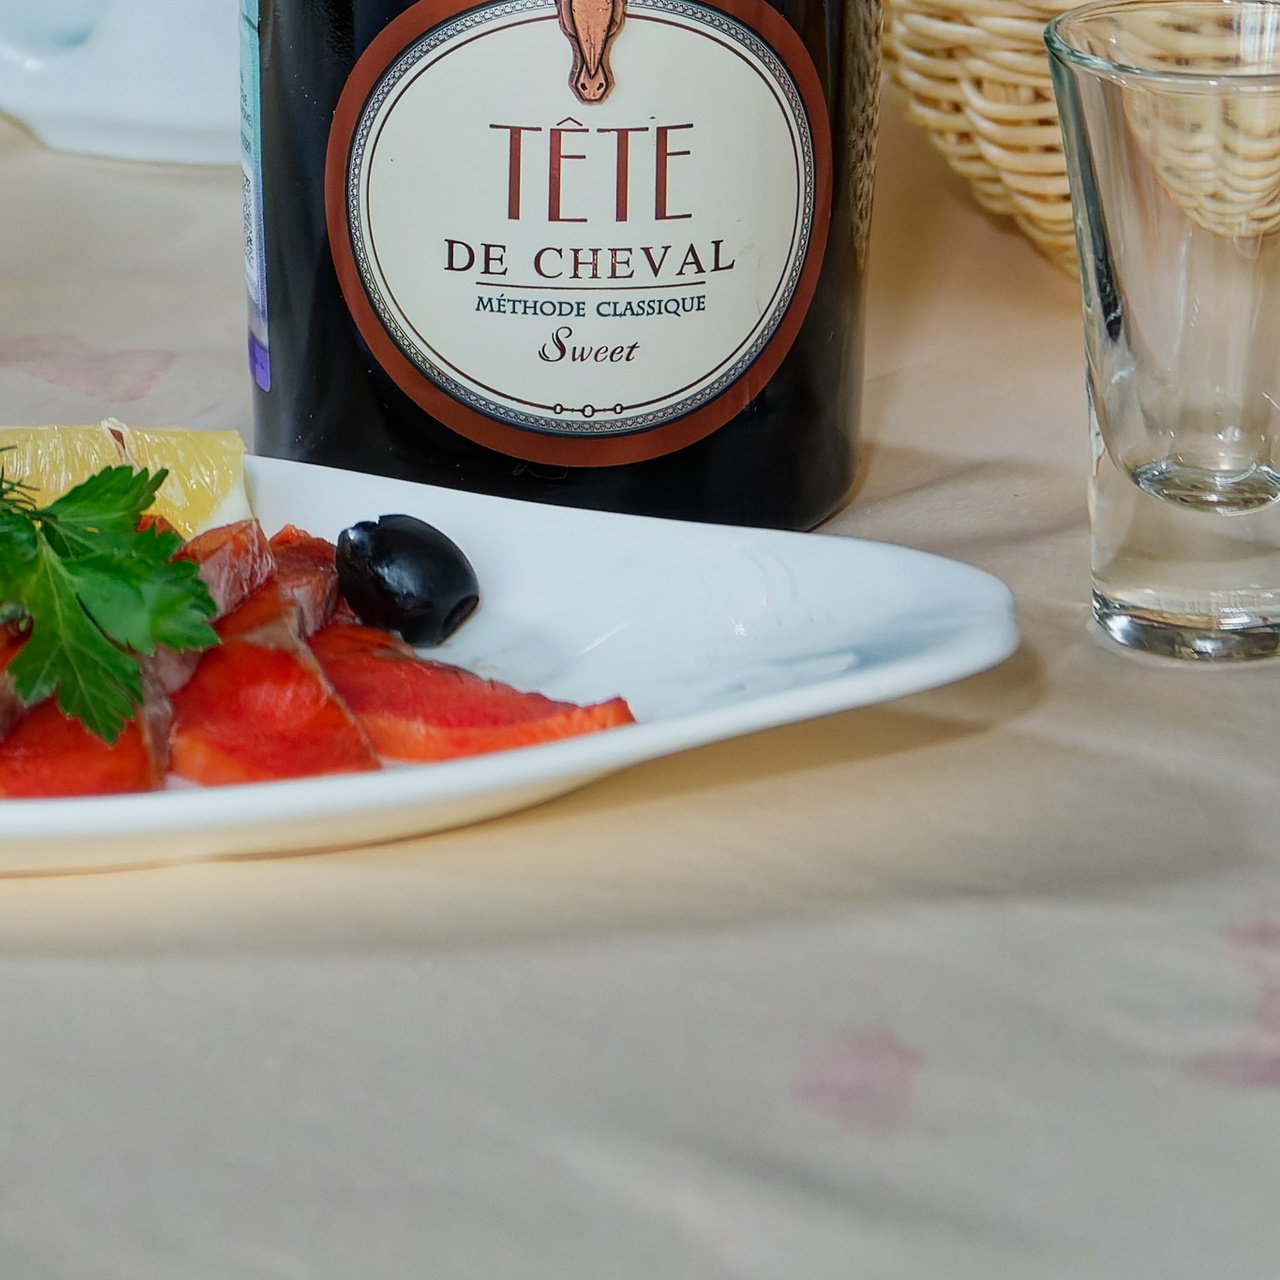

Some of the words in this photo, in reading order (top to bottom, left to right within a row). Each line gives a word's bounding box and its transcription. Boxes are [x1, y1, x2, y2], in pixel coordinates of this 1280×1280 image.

[489, 117, 694, 223] TÊTE
[443, 238, 508, 276] DE
[533, 239, 736, 280] CHEVAL
[474, 293, 586, 318] MÉTHODE
[595, 294, 706, 319] CLASSIQUE
[537, 326, 641, 363] Sweet
